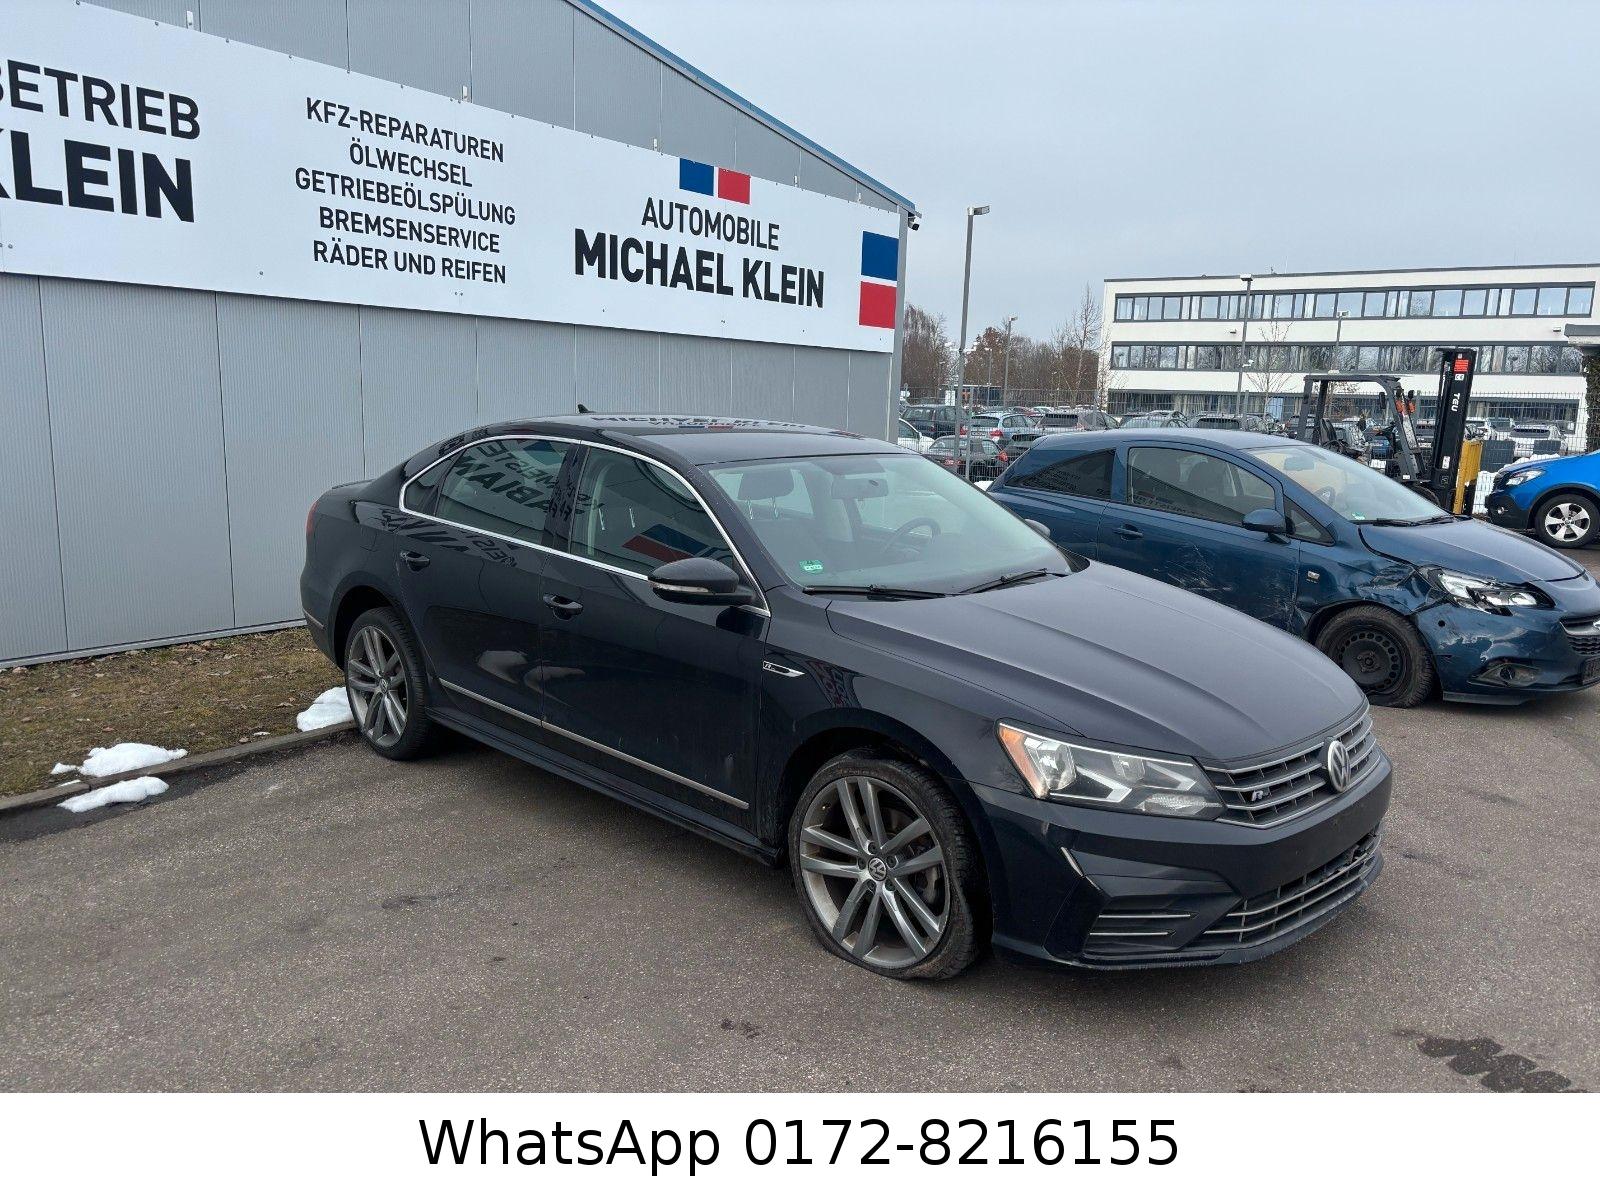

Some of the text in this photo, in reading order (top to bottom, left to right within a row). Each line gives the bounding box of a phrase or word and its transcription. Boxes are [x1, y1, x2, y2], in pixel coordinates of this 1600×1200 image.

[0, 59, 201, 140] ETRIEB
[306, 97, 504, 163] KFZ-REPARATUREN
[349, 142, 473, 188] ÖLWECHSEL
[295, 167, 516, 226] GETRIEBEÖLSPÜLUNG
[641, 196, 780, 251] AUTOMOBILE
[319, 206, 500, 254] BREMSENSERVICE
[313, 239, 506, 284] RÄDER UND REIFEN
[574, 228, 825, 309] MICHAEL KLEIN
